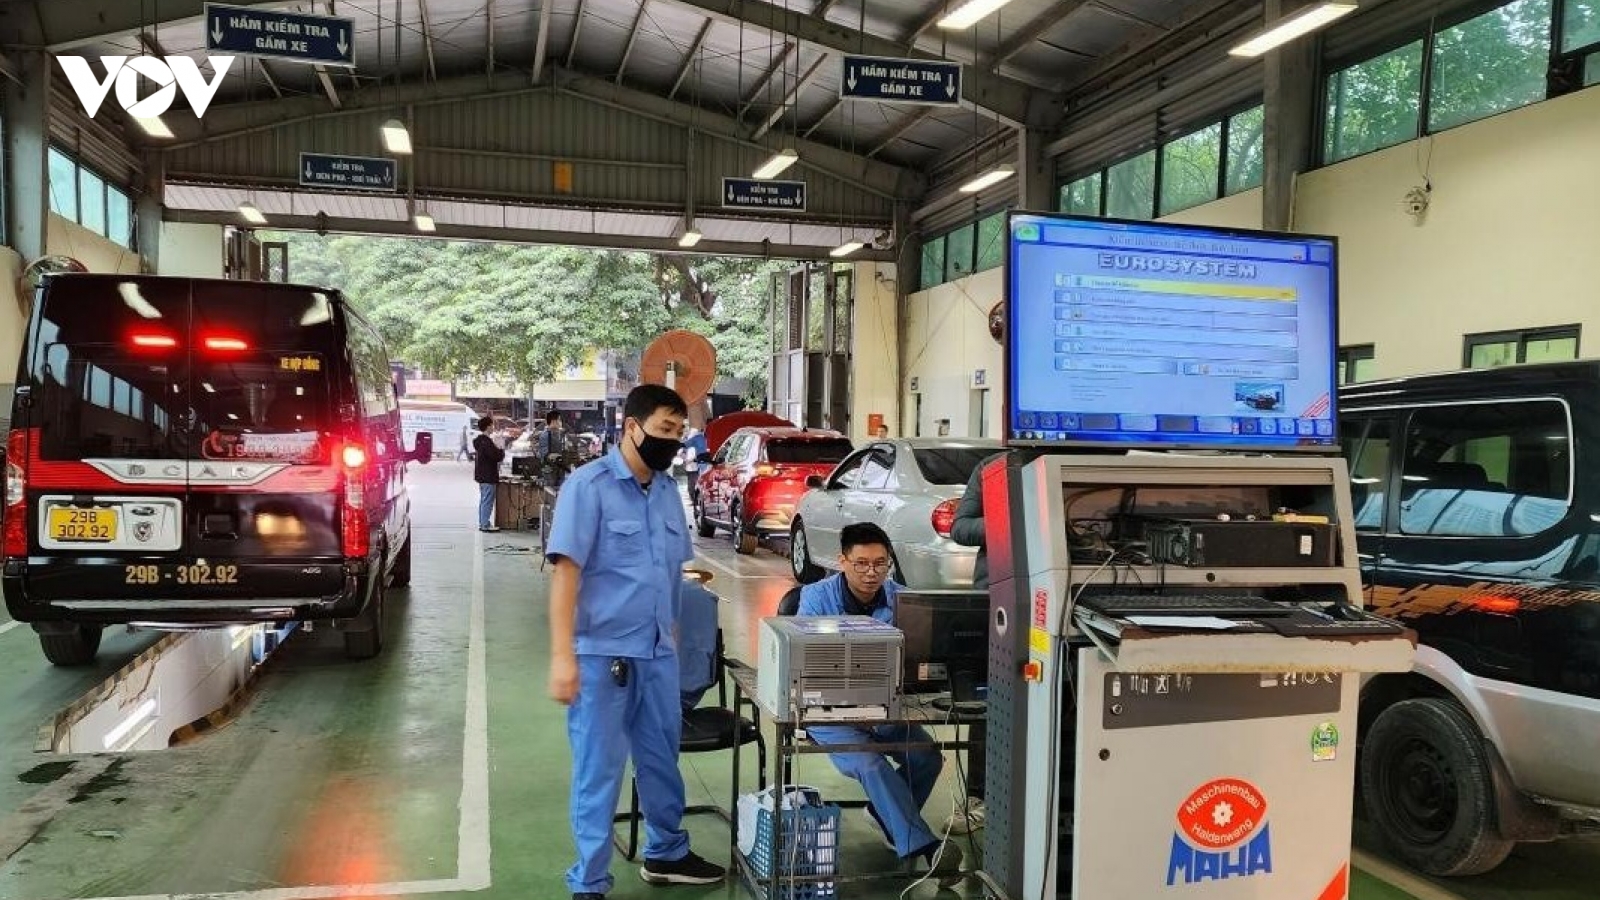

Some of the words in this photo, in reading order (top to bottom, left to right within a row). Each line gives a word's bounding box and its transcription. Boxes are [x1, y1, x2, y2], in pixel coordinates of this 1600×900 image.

[304, 24, 331, 38] TRA
[291, 40, 308, 53] XE
[921, 70, 942, 83] TRA
[909, 85, 924, 96] XE
[1098, 252, 1258, 279] EUROSYSTEM
[69, 511, 97, 523] 29B
[57, 524, 109, 538] 302.92
[125, 565, 160, 584] 29B
[177, 565, 239, 585] 302.92
[1185, 783, 1261, 815] Maschinenbau
[1192, 817, 1254, 845] Haldenwang
[1166, 820, 1273, 886] MAHA
